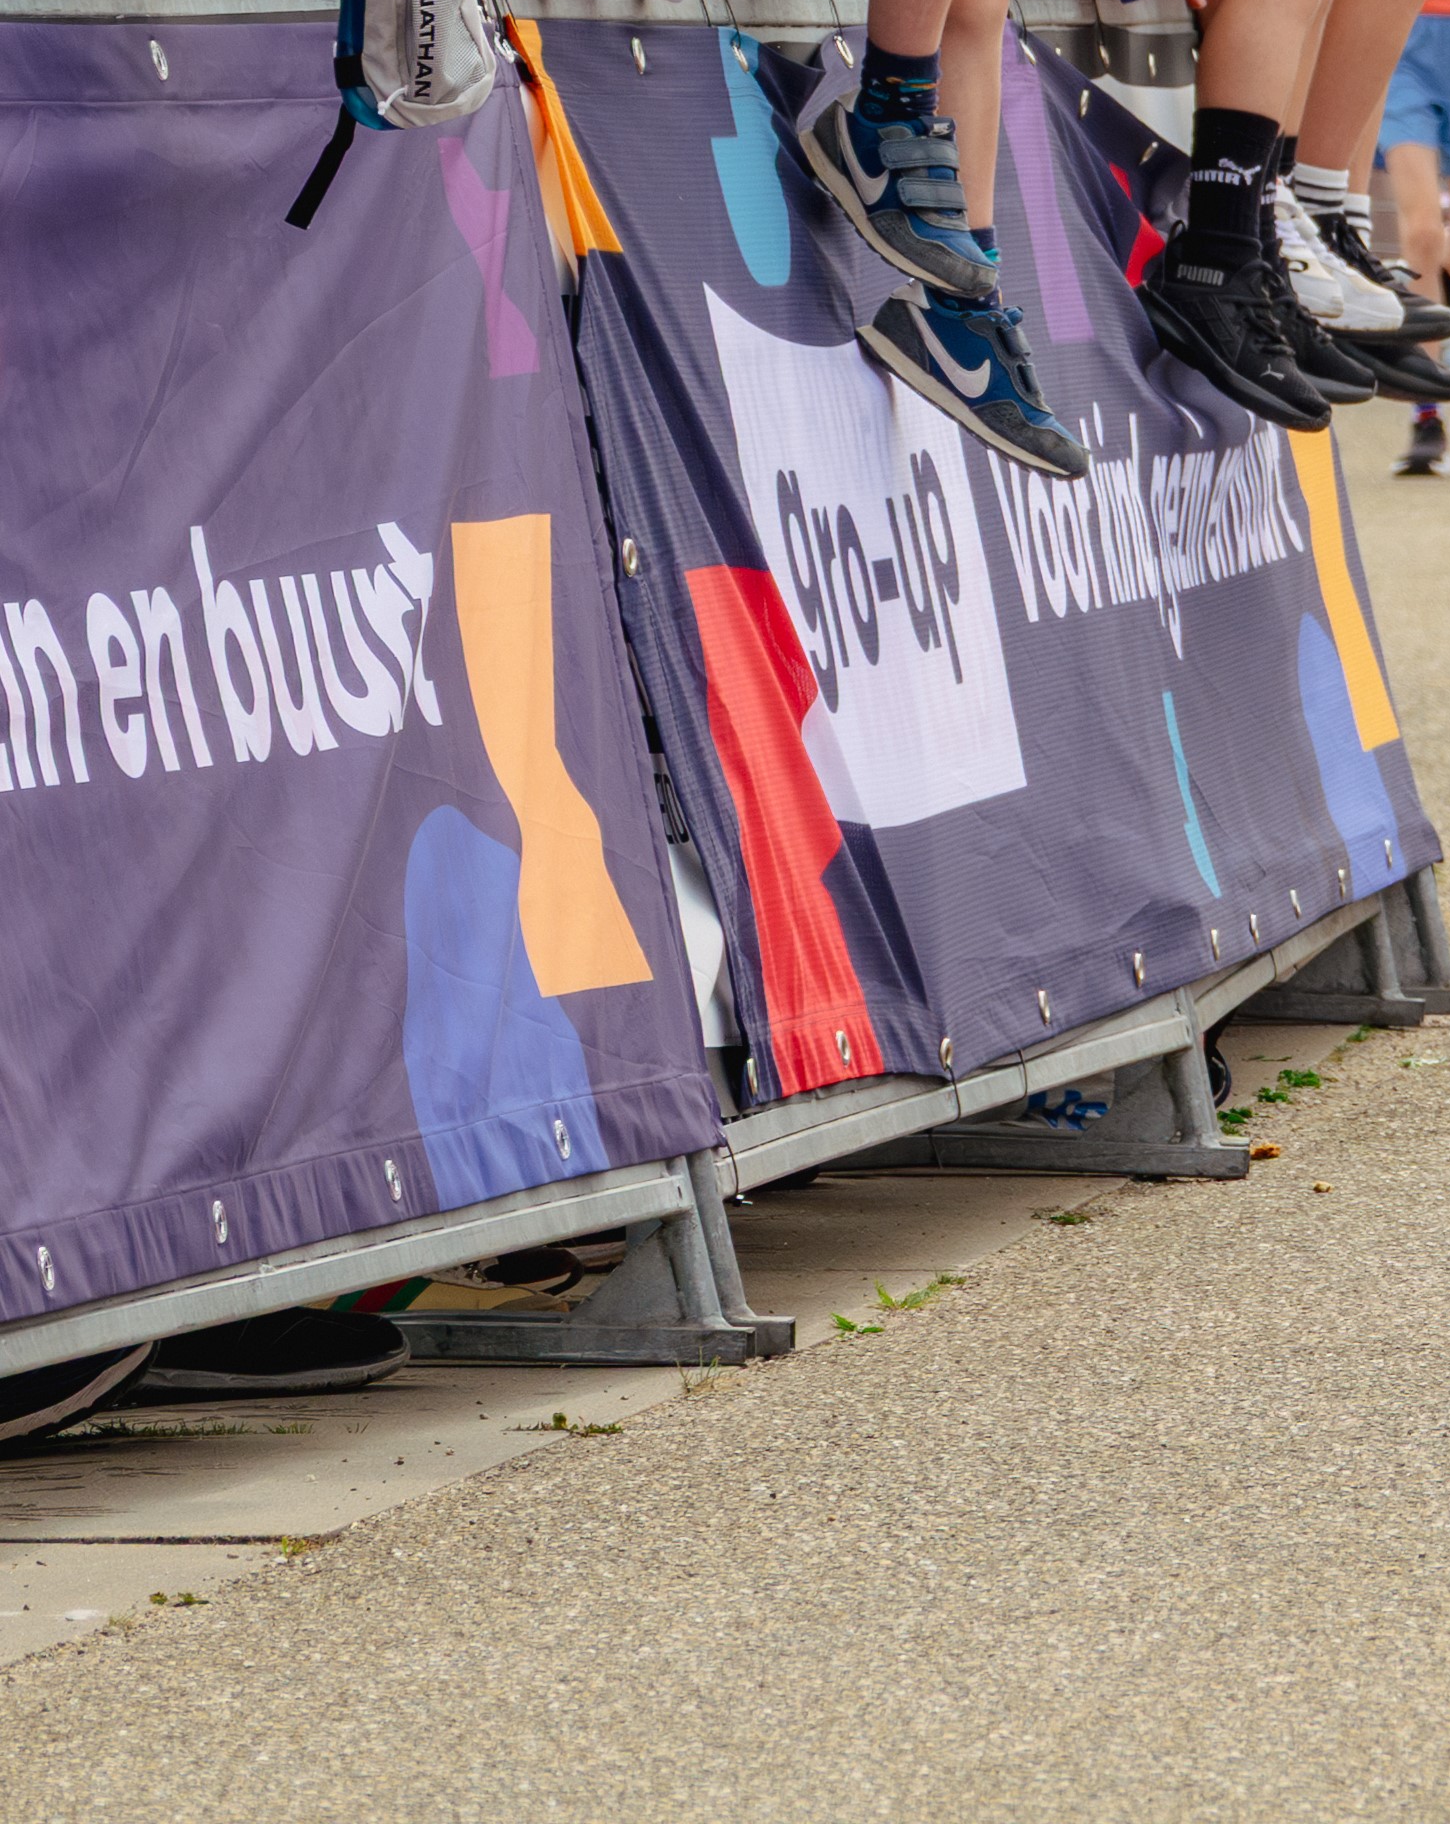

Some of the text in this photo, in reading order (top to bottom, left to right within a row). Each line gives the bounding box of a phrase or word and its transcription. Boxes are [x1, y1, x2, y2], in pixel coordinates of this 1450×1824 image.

[1177, 264, 1224, 286] PUMA
[776, 449, 963, 713] gro-up
[987, 446, 1102, 622] Voor
[86, 587, 213, 778] en
